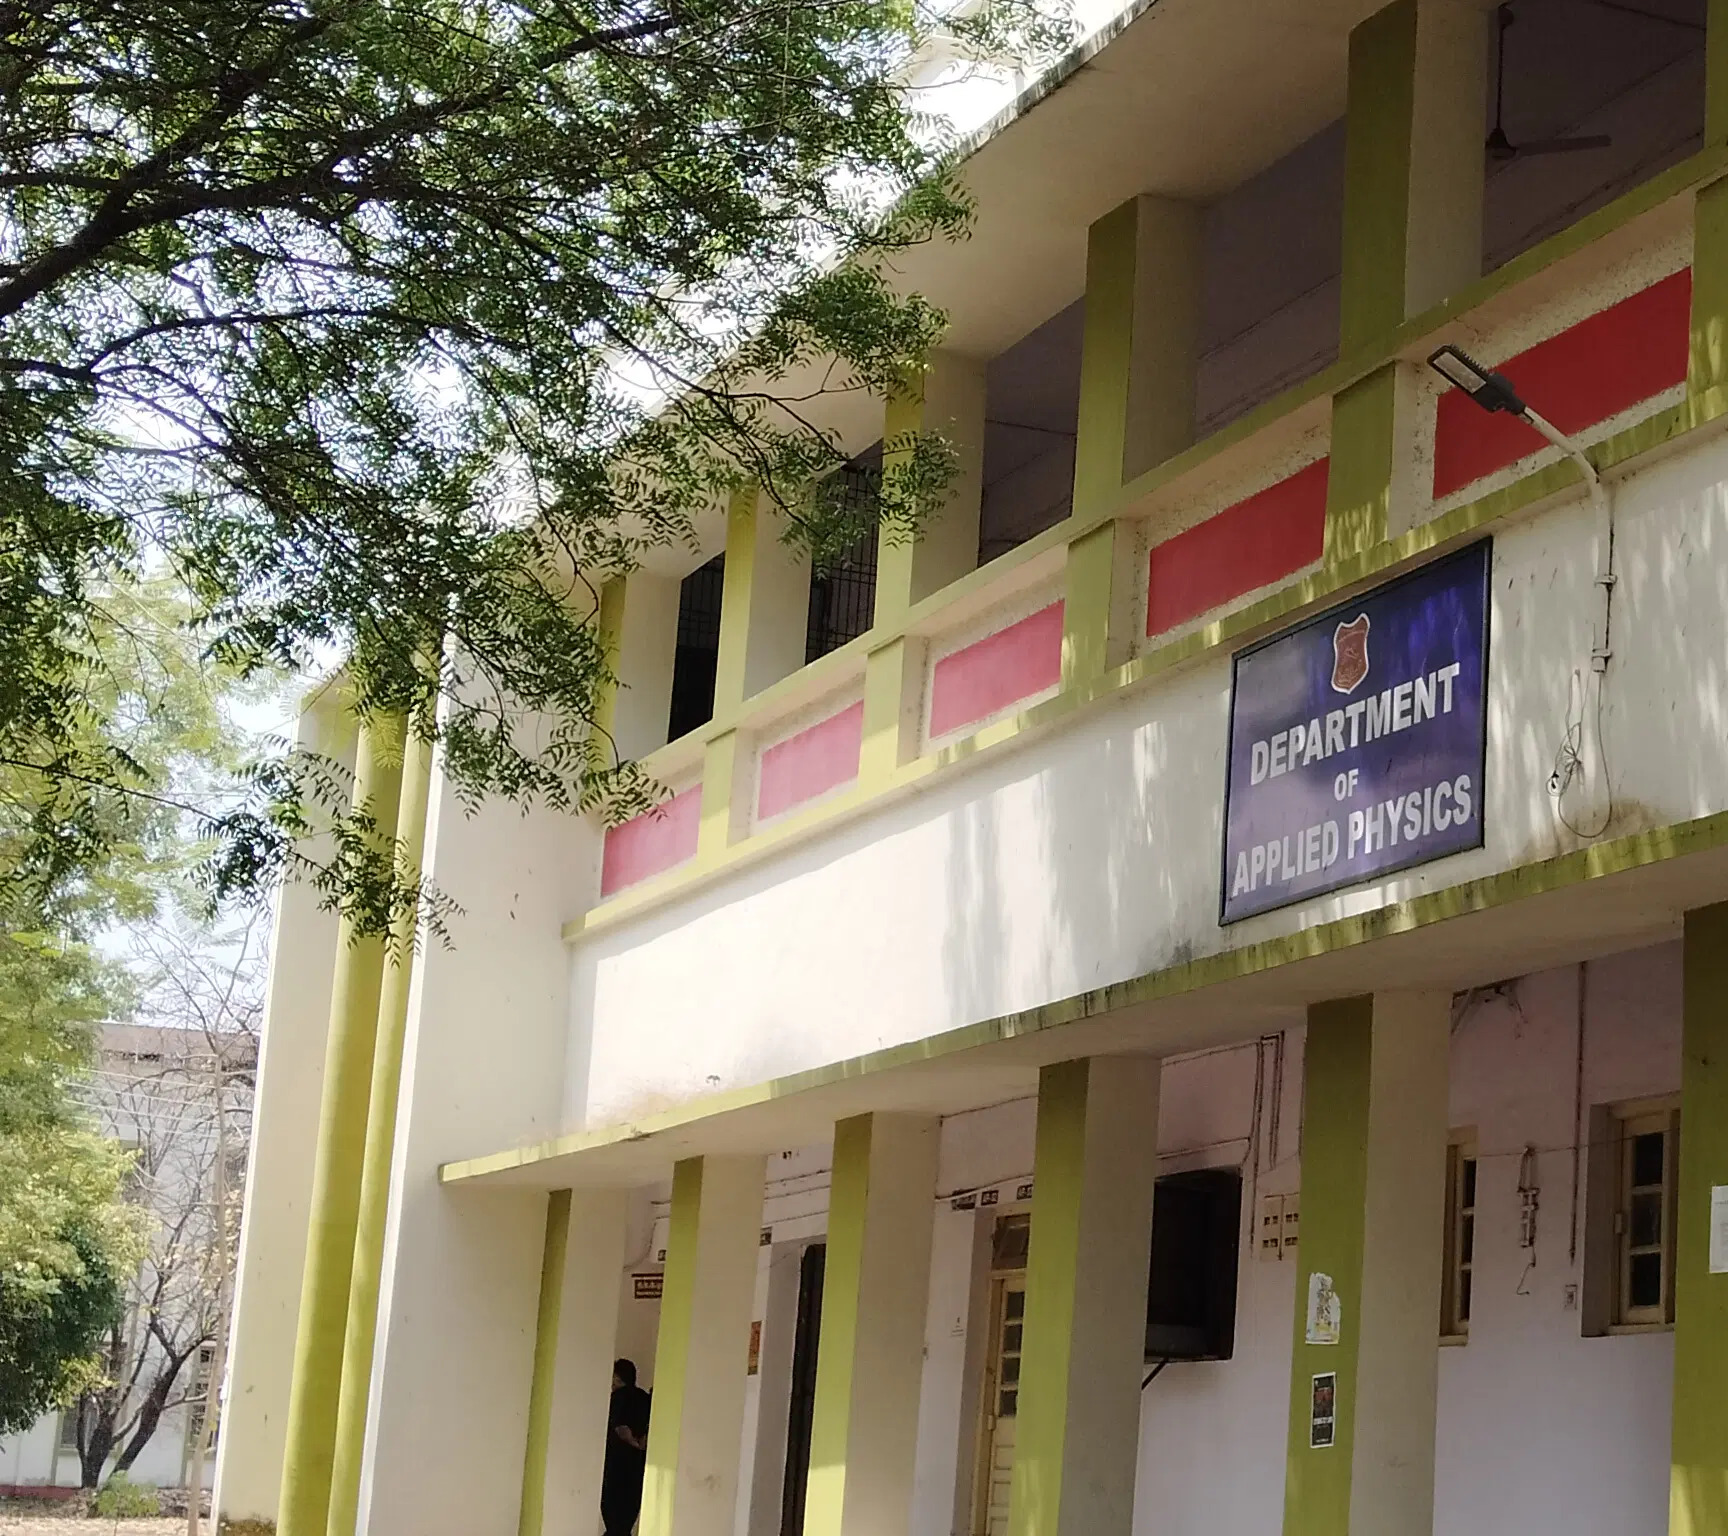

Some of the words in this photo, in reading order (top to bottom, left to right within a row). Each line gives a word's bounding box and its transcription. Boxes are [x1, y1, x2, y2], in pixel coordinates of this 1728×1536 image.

[1251, 662, 1460, 786] DEPARTMENT
[1334, 769, 1358, 801] OF
[1231, 820, 1339, 897] APPLIED
[1347, 774, 1472, 860] PHYSICS
